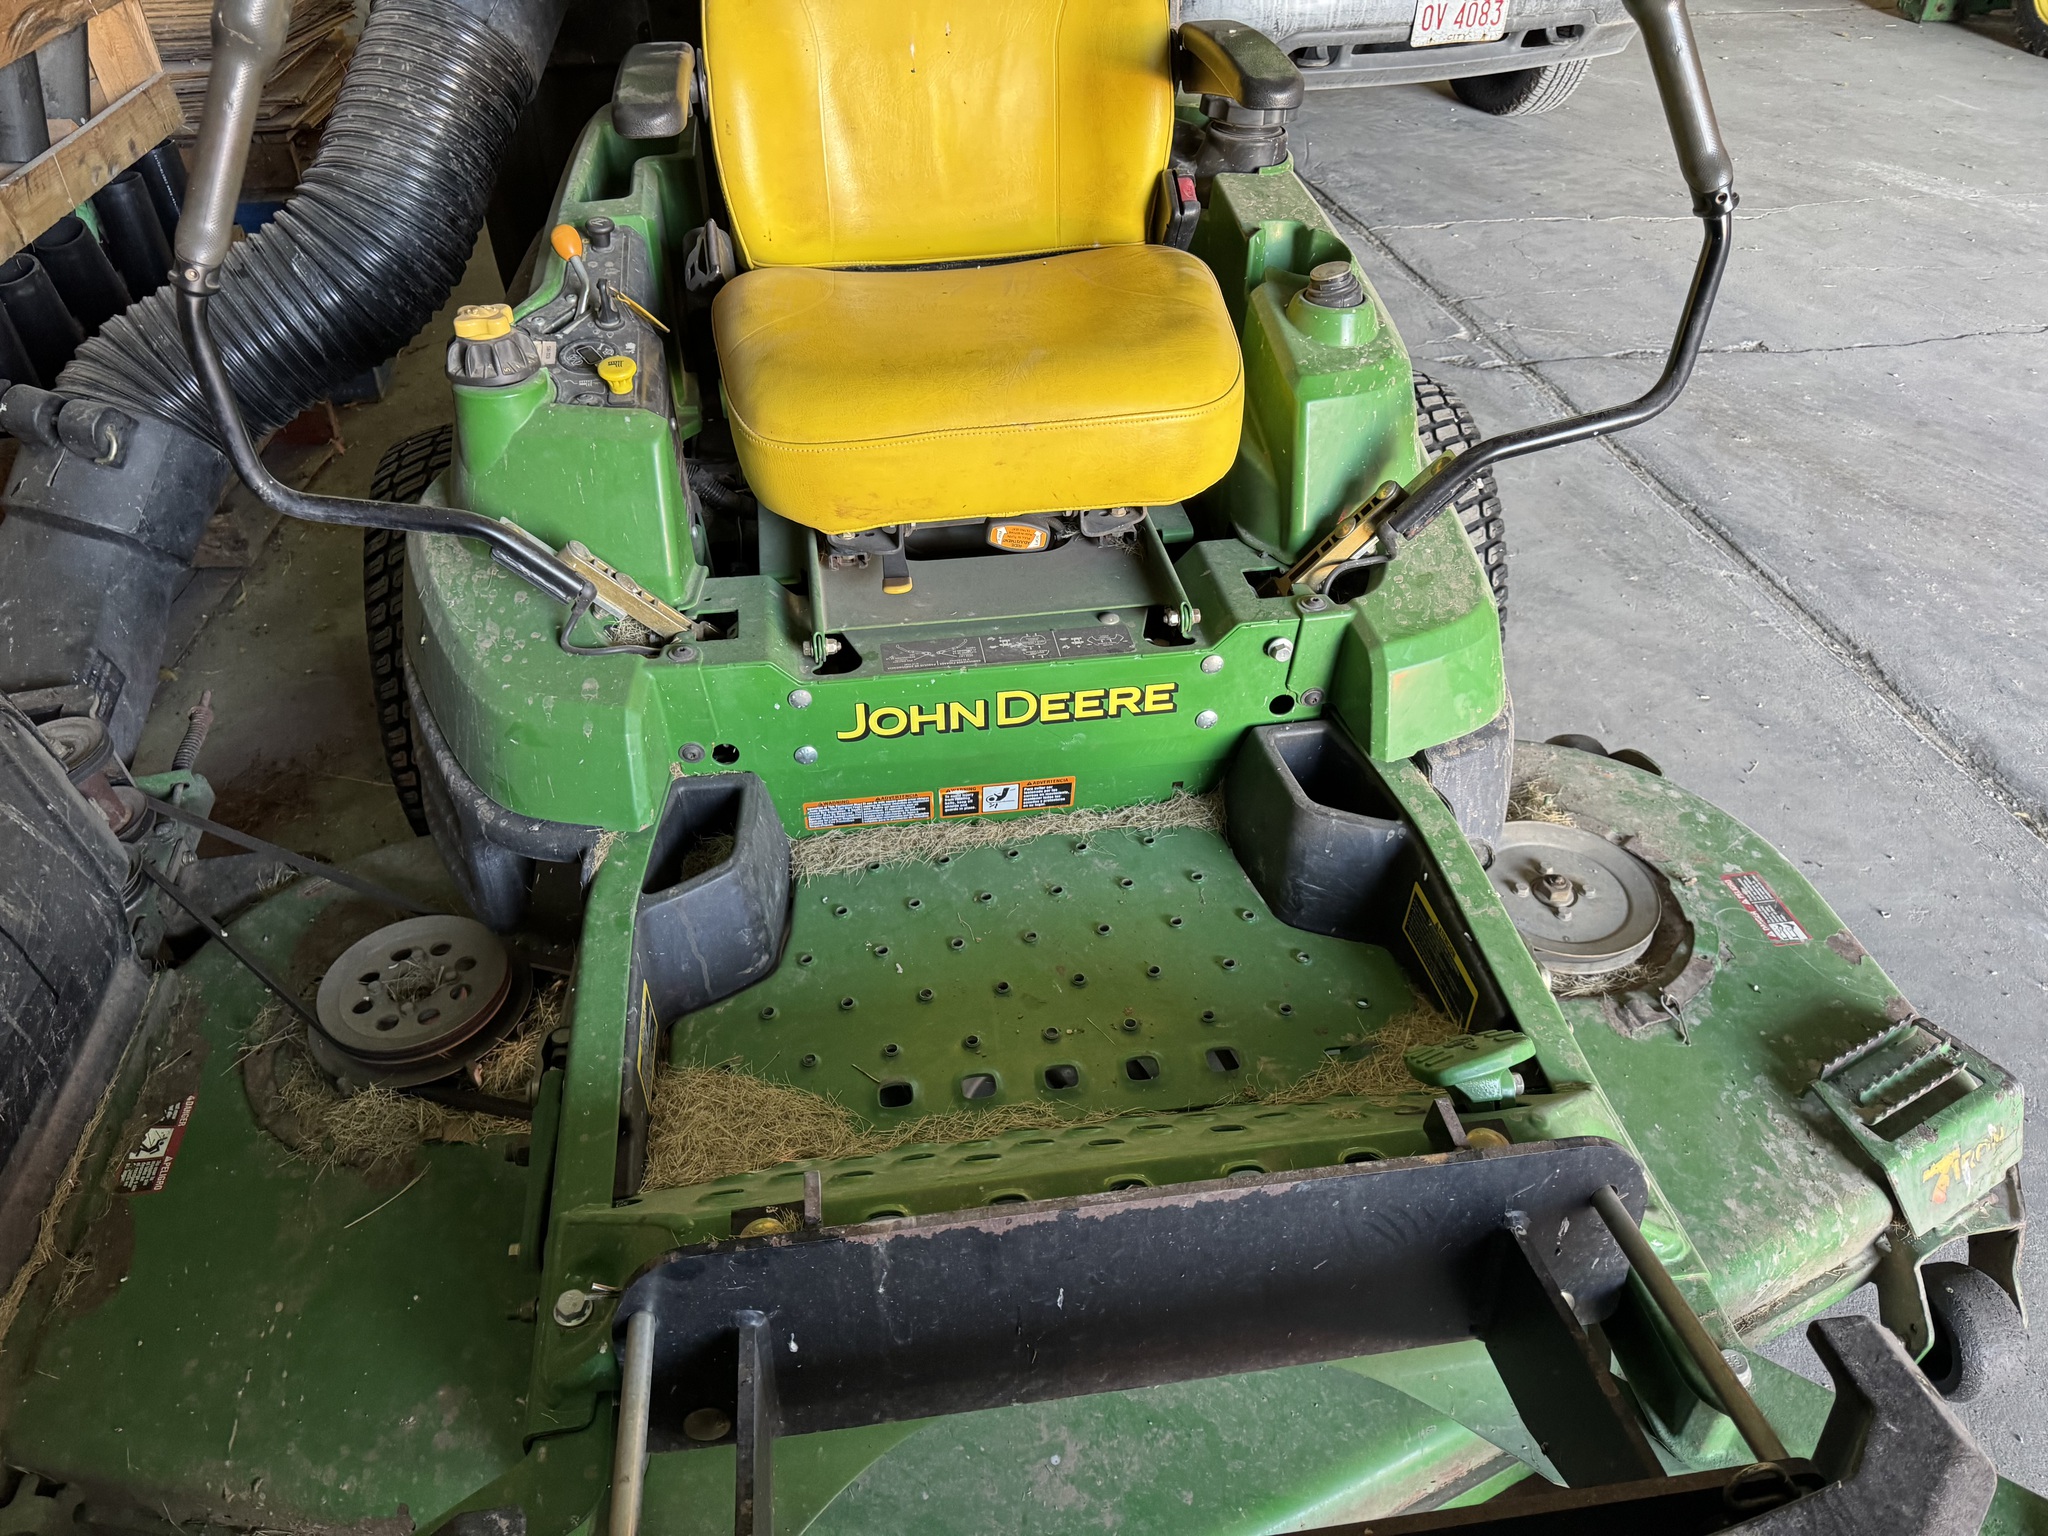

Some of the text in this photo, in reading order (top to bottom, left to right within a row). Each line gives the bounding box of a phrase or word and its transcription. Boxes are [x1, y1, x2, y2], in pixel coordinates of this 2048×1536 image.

[1454, 0, 1504, 29] 4083
[836, 682, 1180, 742] JOHN DEERE
[881, 793, 918, 801] ADVERTENCIA
[178, 1101, 194, 1127] DANGER
[154, 1162, 173, 1191] PELIGRO
